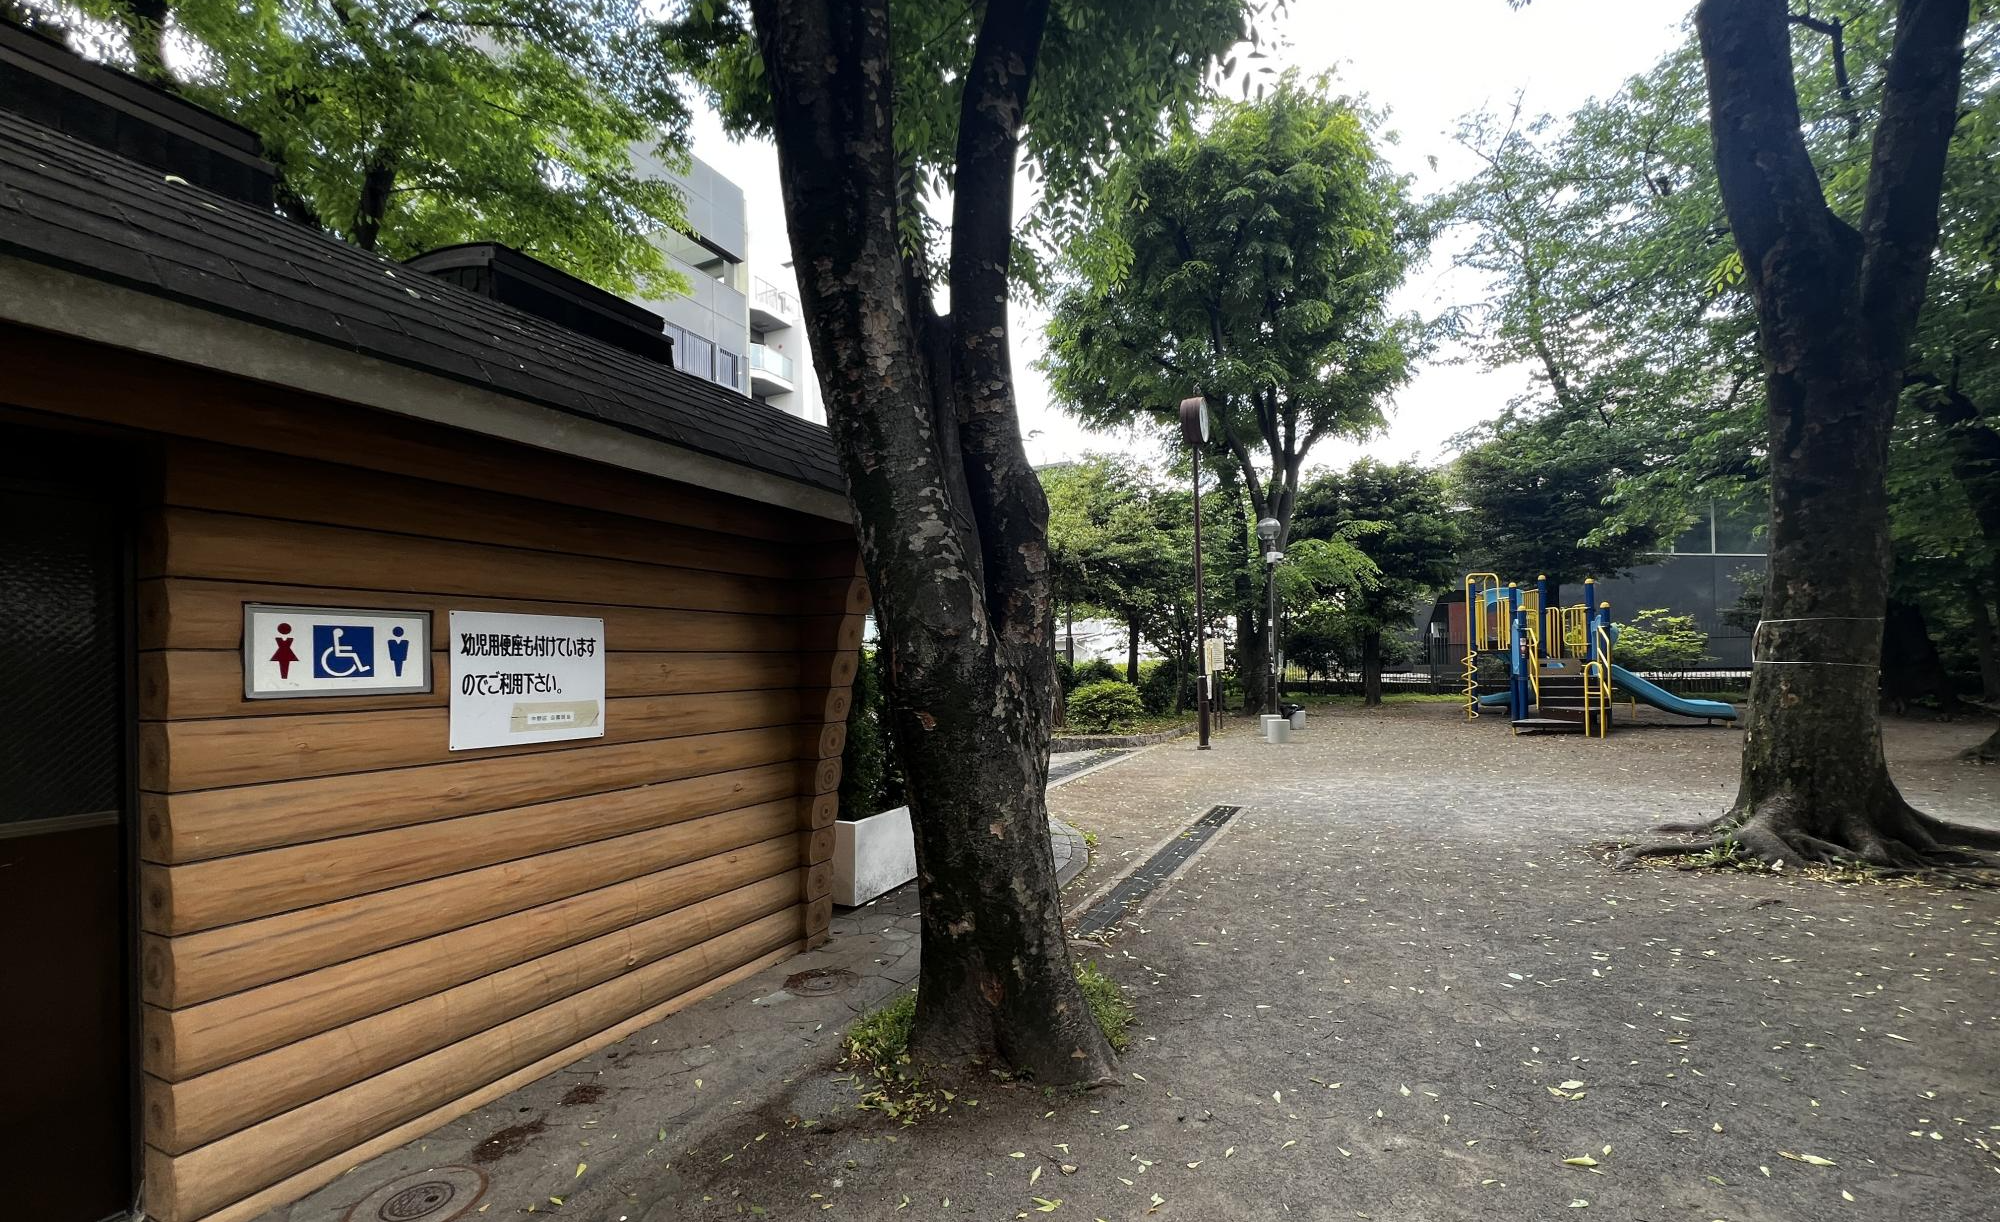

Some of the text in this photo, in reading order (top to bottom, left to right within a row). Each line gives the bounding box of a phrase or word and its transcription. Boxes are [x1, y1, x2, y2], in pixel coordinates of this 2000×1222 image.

[461, 633, 596, 658] 幼児用便座も付けています
[462, 671, 562, 695] のでご利用下さい。
